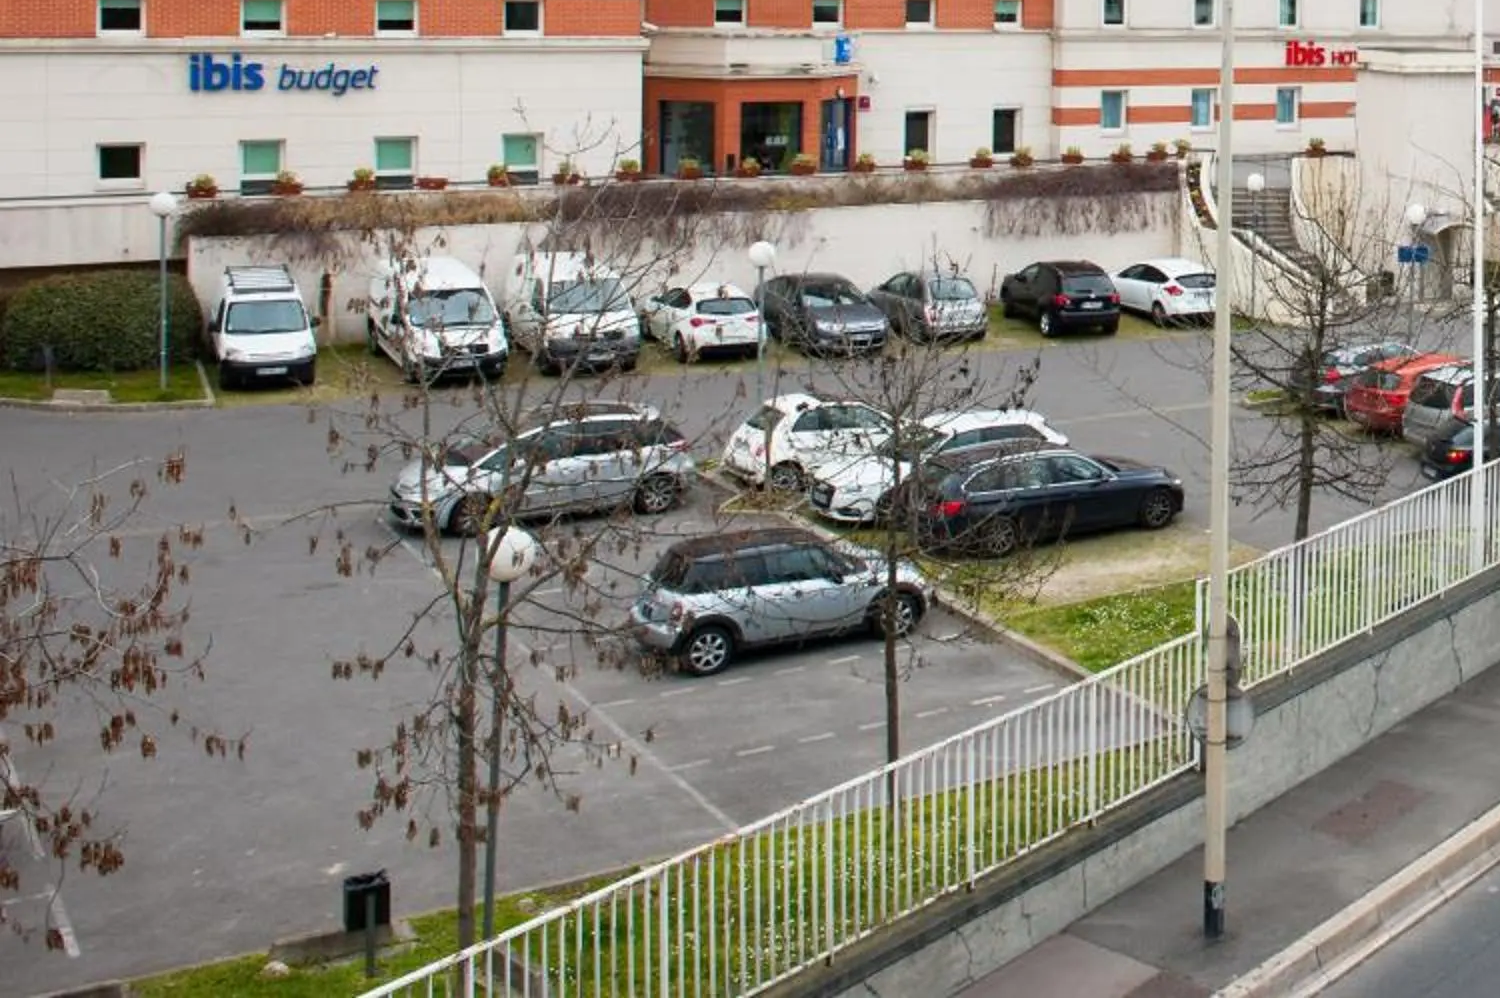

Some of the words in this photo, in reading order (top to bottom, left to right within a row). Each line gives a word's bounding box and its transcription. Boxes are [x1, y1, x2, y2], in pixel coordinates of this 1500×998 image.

[1286, 39, 1325, 66] ibis
[189, 53, 265, 91] ibis
[278, 64, 379, 96] budget
